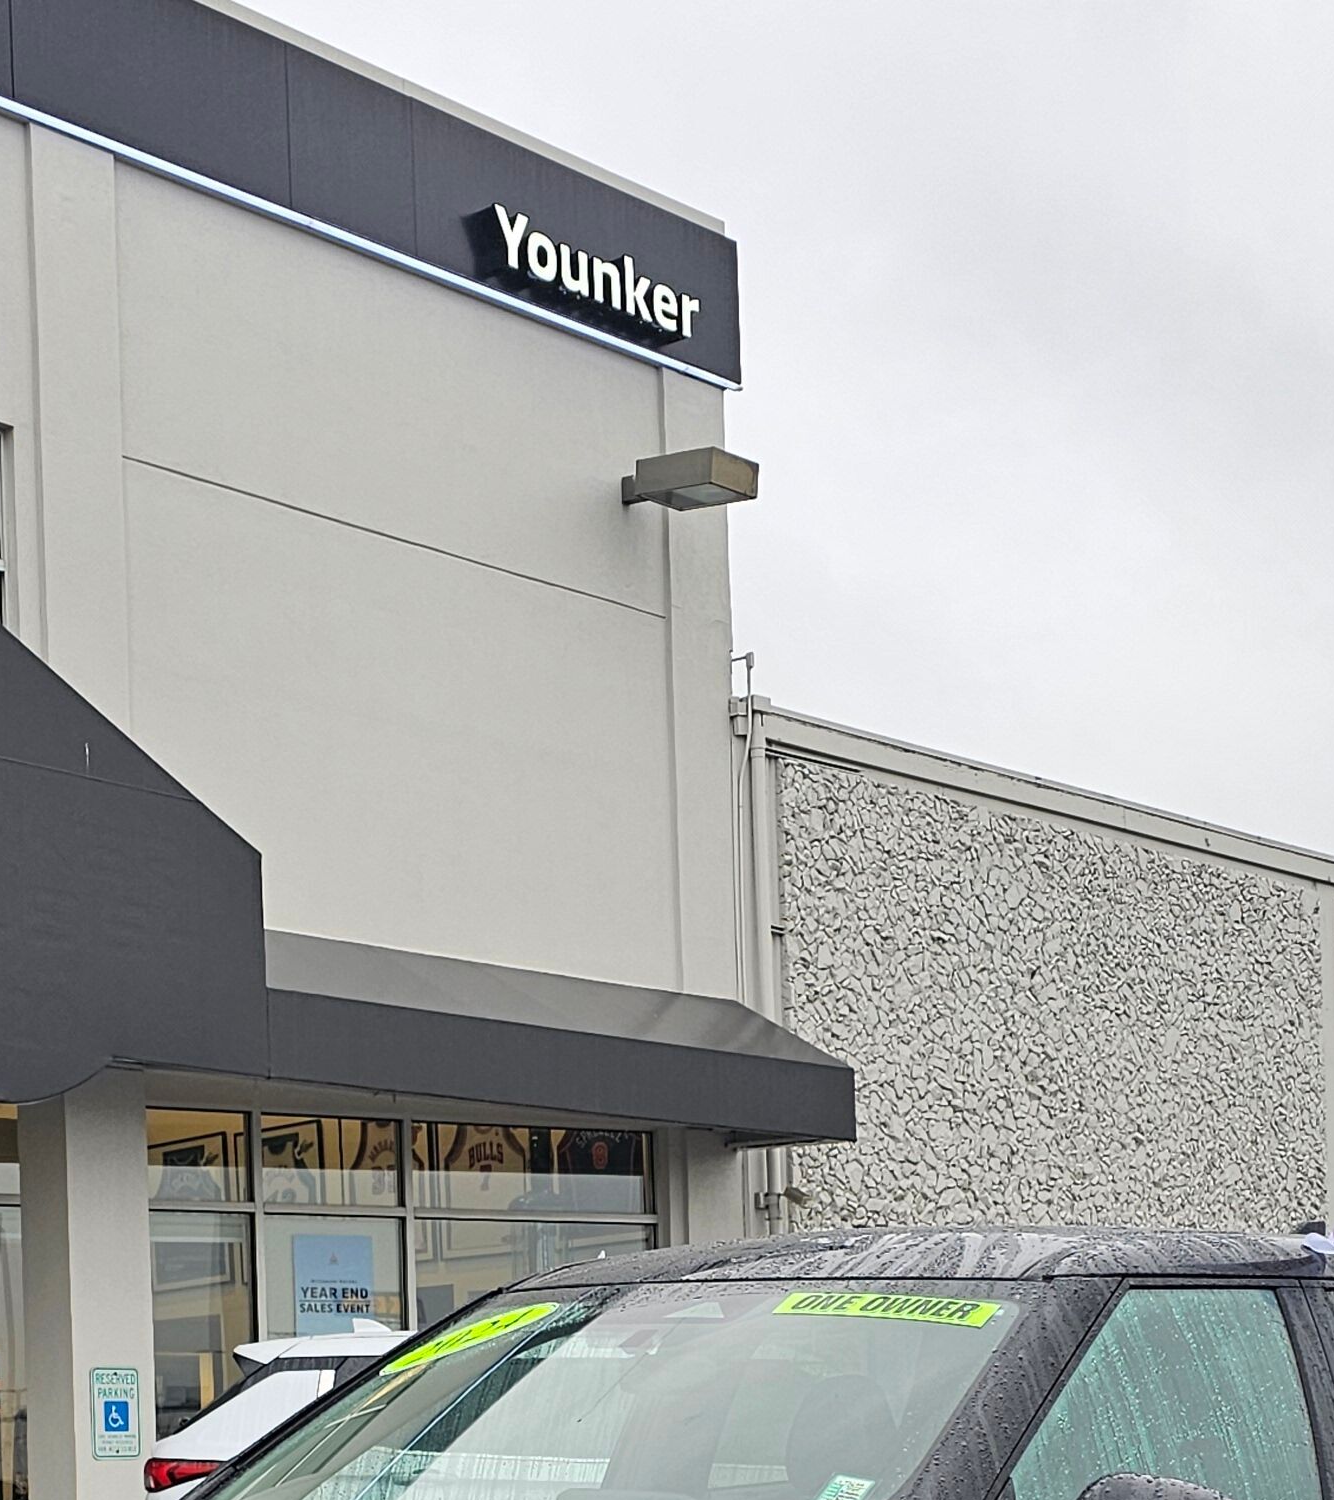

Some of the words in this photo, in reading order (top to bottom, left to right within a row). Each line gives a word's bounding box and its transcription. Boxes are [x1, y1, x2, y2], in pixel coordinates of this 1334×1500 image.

[493, 203, 700, 338] Younker
[468, 1141, 504, 1169] BULLS
[301, 1287, 337, 1299] YEAR
[342, 1288, 369, 1299] END
[299, 1303, 333, 1314] SALES
[336, 1304, 371, 1314] EVENT
[791, 1295, 862, 1310] ONE
[860, 1297, 980, 1319] OWNER
[95, 1373, 136, 1385] RESERVED
[98, 1388, 135, 1400] PARKING
